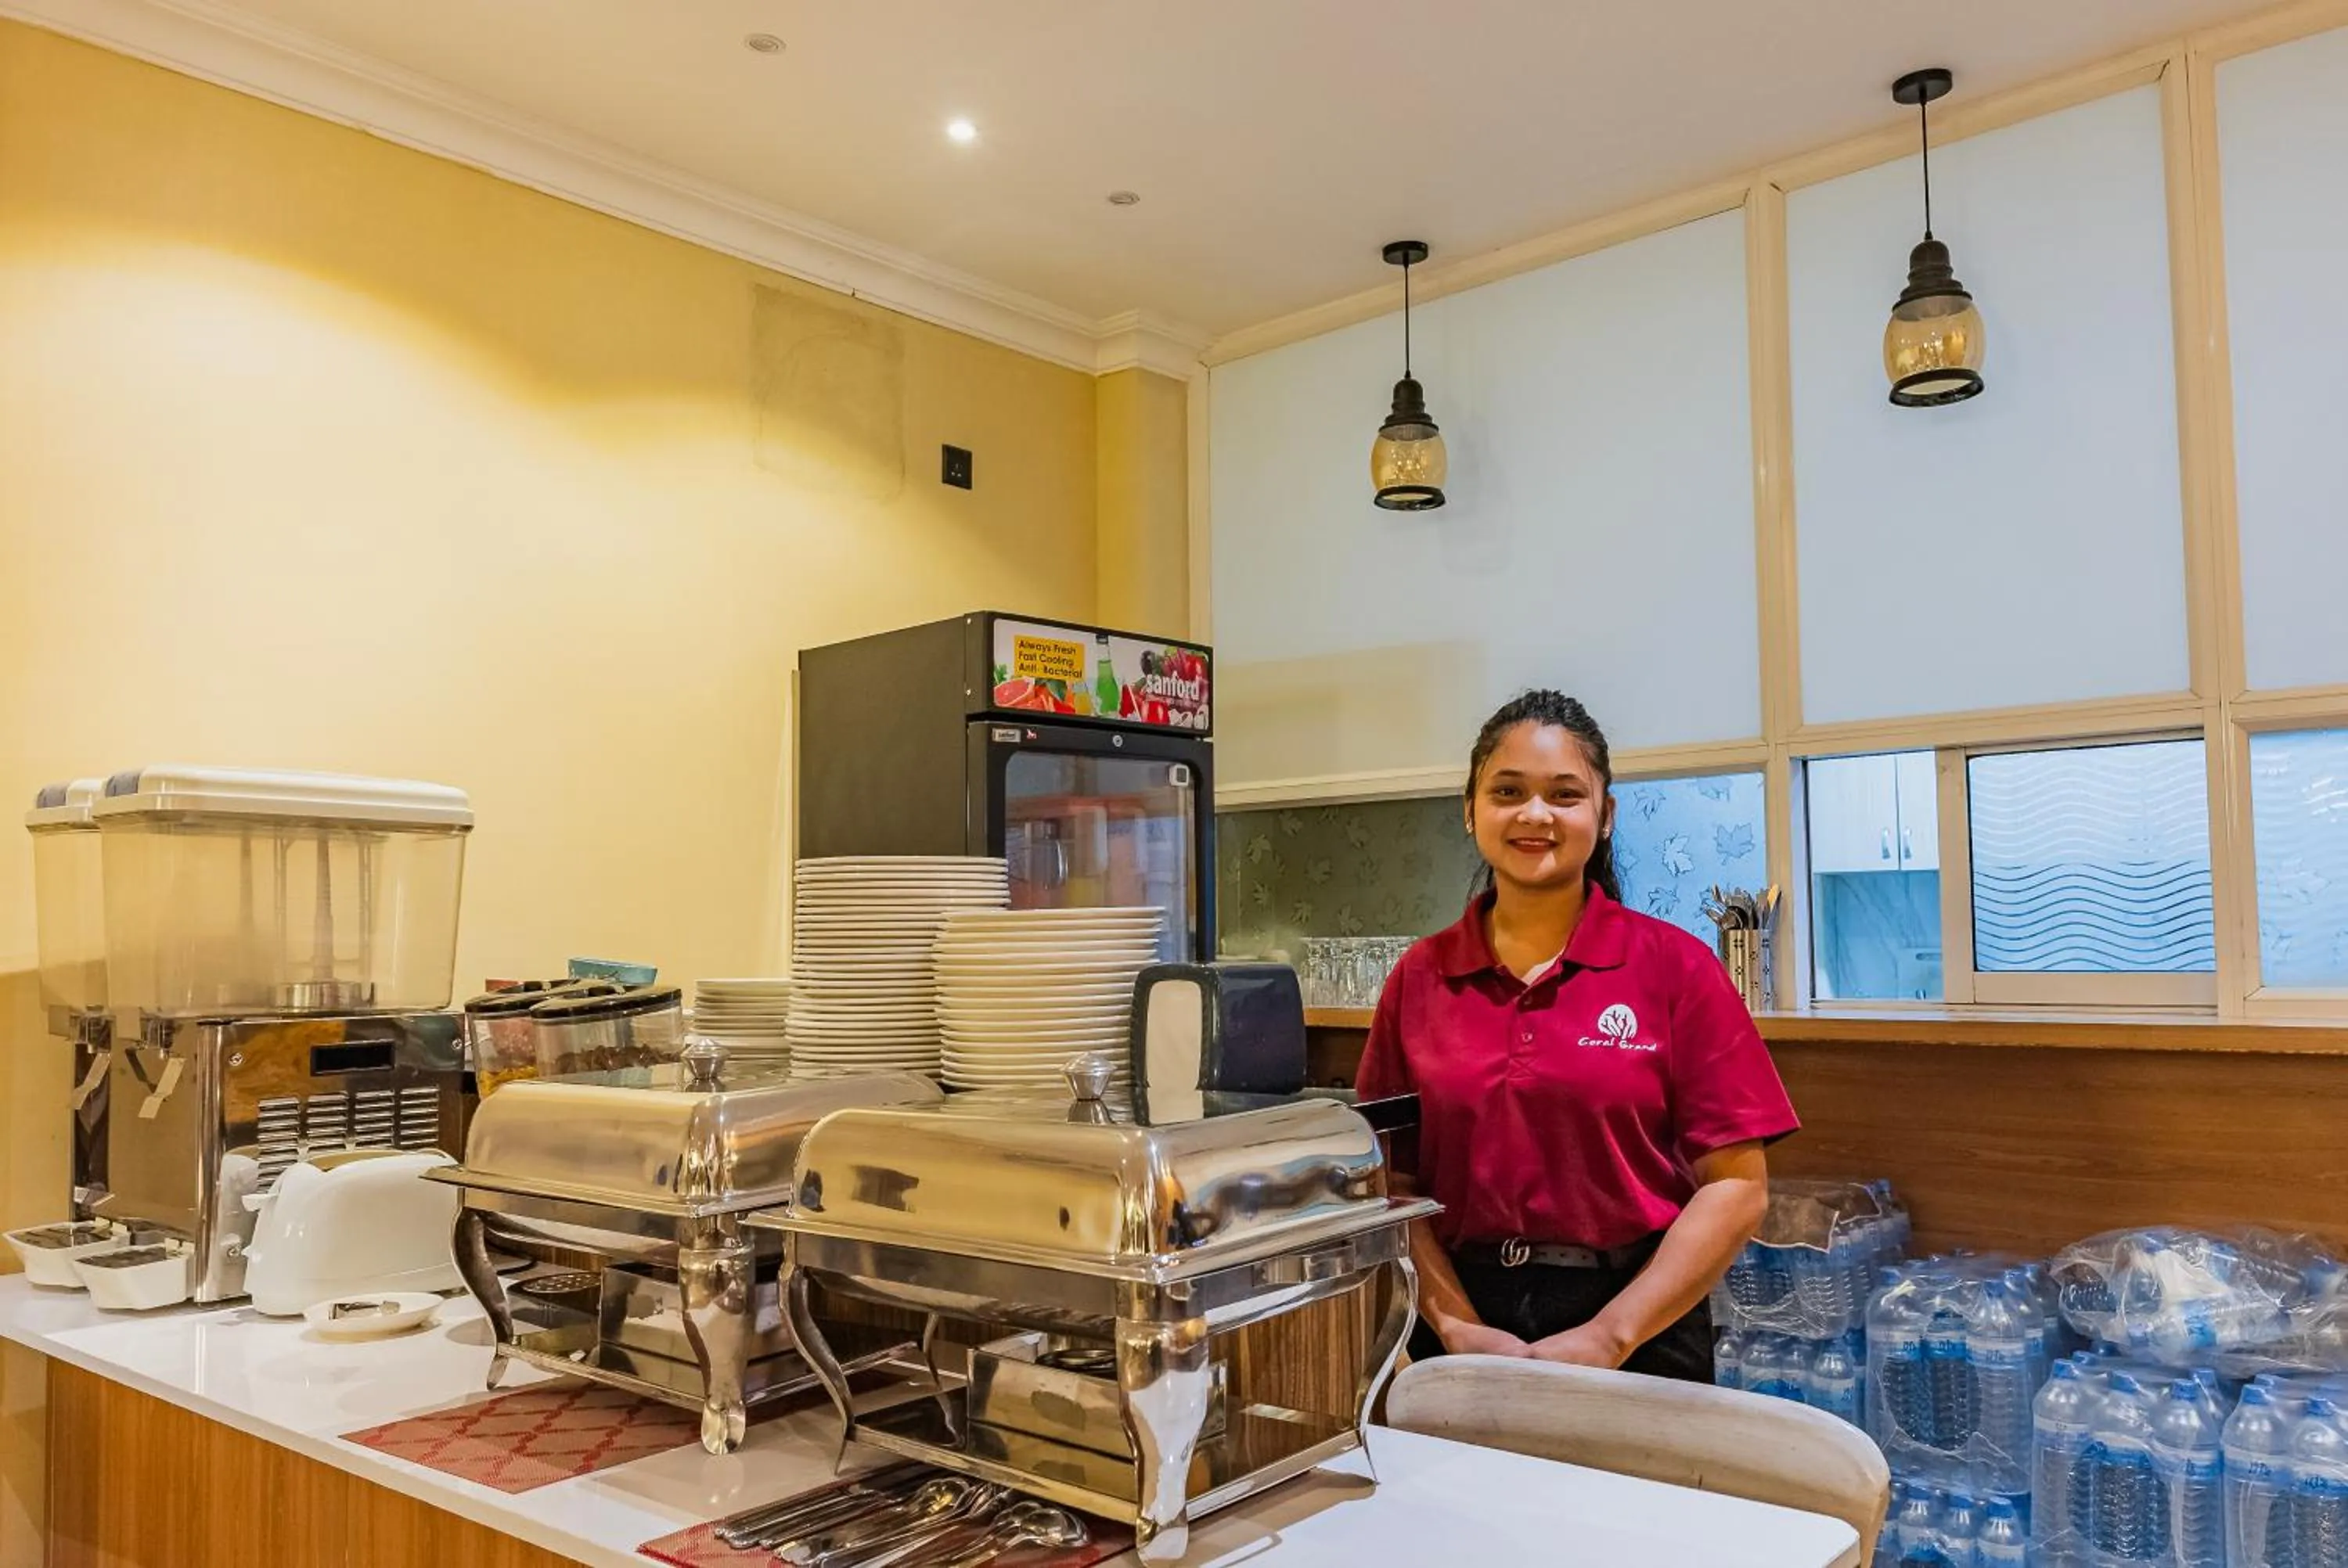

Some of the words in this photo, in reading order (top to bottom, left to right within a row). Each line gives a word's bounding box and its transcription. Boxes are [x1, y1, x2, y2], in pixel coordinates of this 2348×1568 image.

[1018, 639, 1051, 653] Always
[1053, 644, 1076, 655] Fresh
[1018, 651, 1037, 661] Fast
[1039, 654, 1075, 668] Cooling
[1043, 665, 1082, 678] Bacterial
[1145, 670, 1201, 701] sanford
[1577, 1037, 1615, 1047] Coral
[1619, 1040, 1658, 1052] Grand
